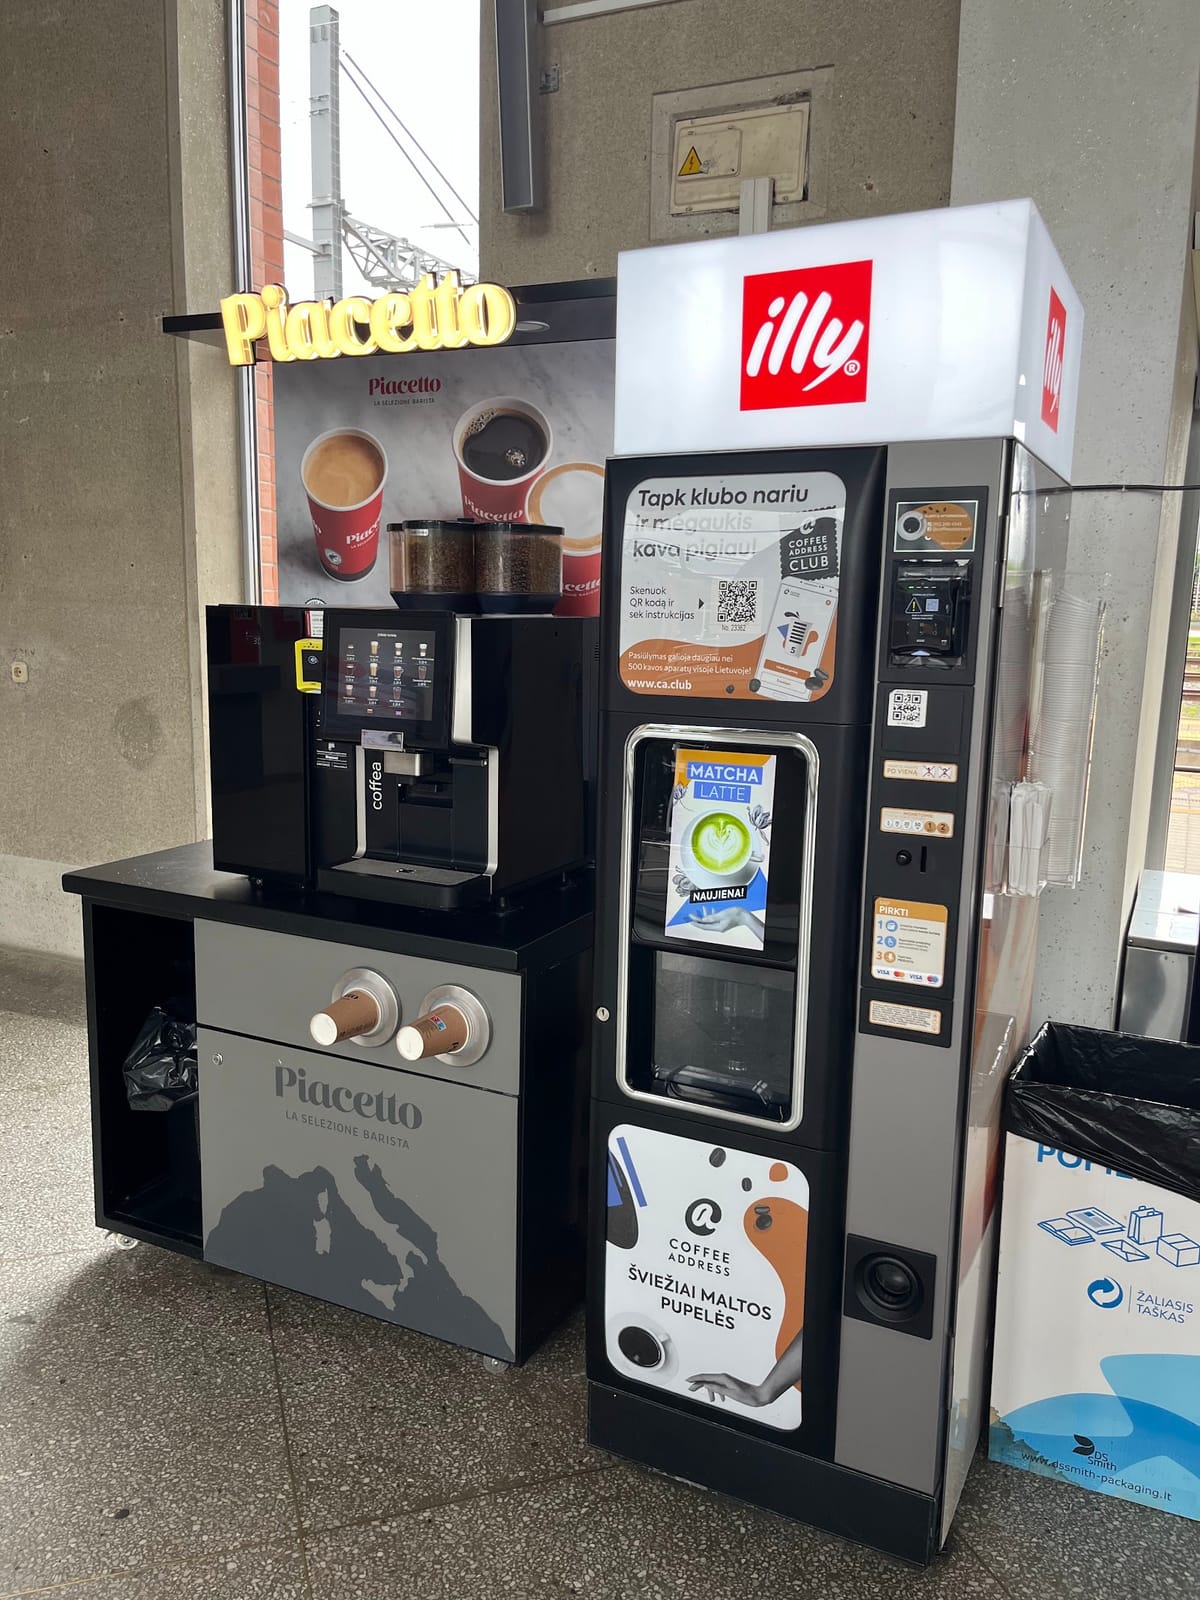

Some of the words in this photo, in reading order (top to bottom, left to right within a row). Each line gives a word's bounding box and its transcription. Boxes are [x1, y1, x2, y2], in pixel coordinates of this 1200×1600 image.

[221, 270, 517, 366] Piacetto
[368, 376, 441, 396] Piacetto
[638, 489, 686, 510] Tapk
[691, 487, 747, 506] klubo
[753, 483, 809, 504] nariu
[789, 535, 828, 548] COFFEE
[789, 544, 828, 556] ADDRESS
[789, 555, 829, 572] CLUB
[629, 586, 667, 595] Skenuok
[629, 598, 643, 607] QR
[645, 598, 666, 609] kodą
[668, 598, 675, 607] ir
[629, 610, 643, 619] sek
[645, 610, 695, 622] instrukcijas
[628, 651, 667, 661] Pasiūlymas
[667, 653, 691, 663] galioja
[692, 654, 721, 663] daugiau
[789, 646, 797, 654] 5
[628, 663, 642, 671] 500
[643, 664, 663, 672] kavos
[663, 665, 692, 674] aparatų
[693, 666, 714, 675] visoje
[714, 666, 752, 676] Lietuvoje!
[627, 679, 692, 690] www.ca.club
[690, 763, 759, 783] MATCHA
[368, 761, 383, 811] coffea
[699, 783, 745, 802] LATTE
[692, 887, 744, 902] NAUJIENA!
[879, 905, 909, 917] PIRKTI
[877, 920, 883, 929] 1
[876, 935, 884, 945] 2
[876, 951, 883, 960] 3
[909, 973, 923, 981] VISA
[276, 1066, 422, 1129] Piacetto
[285, 1110, 298, 1122] LA
[301, 1112, 359, 1138] SELEZIONE
[363, 1128, 410, 1150] BARISTA
[668, 1237, 731, 1264] COFFEE
[668, 1252, 732, 1277] ADDRESS
[628, 1263, 697, 1300] ŠVIEŽIAI
[701, 1286, 773, 1321] MALTOS
[1136, 1290, 1194, 1313] ŽALIASIS
[660, 1295, 736, 1331] PUPELĖS
[1136, 1303, 1185, 1324] TAŠKAS
[1087, 1455, 1117, 1471] Smith
[1094, 1451, 1108, 1462] DS
[1021, 1452, 1173, 1502] www.dssmith-packaging.lt
